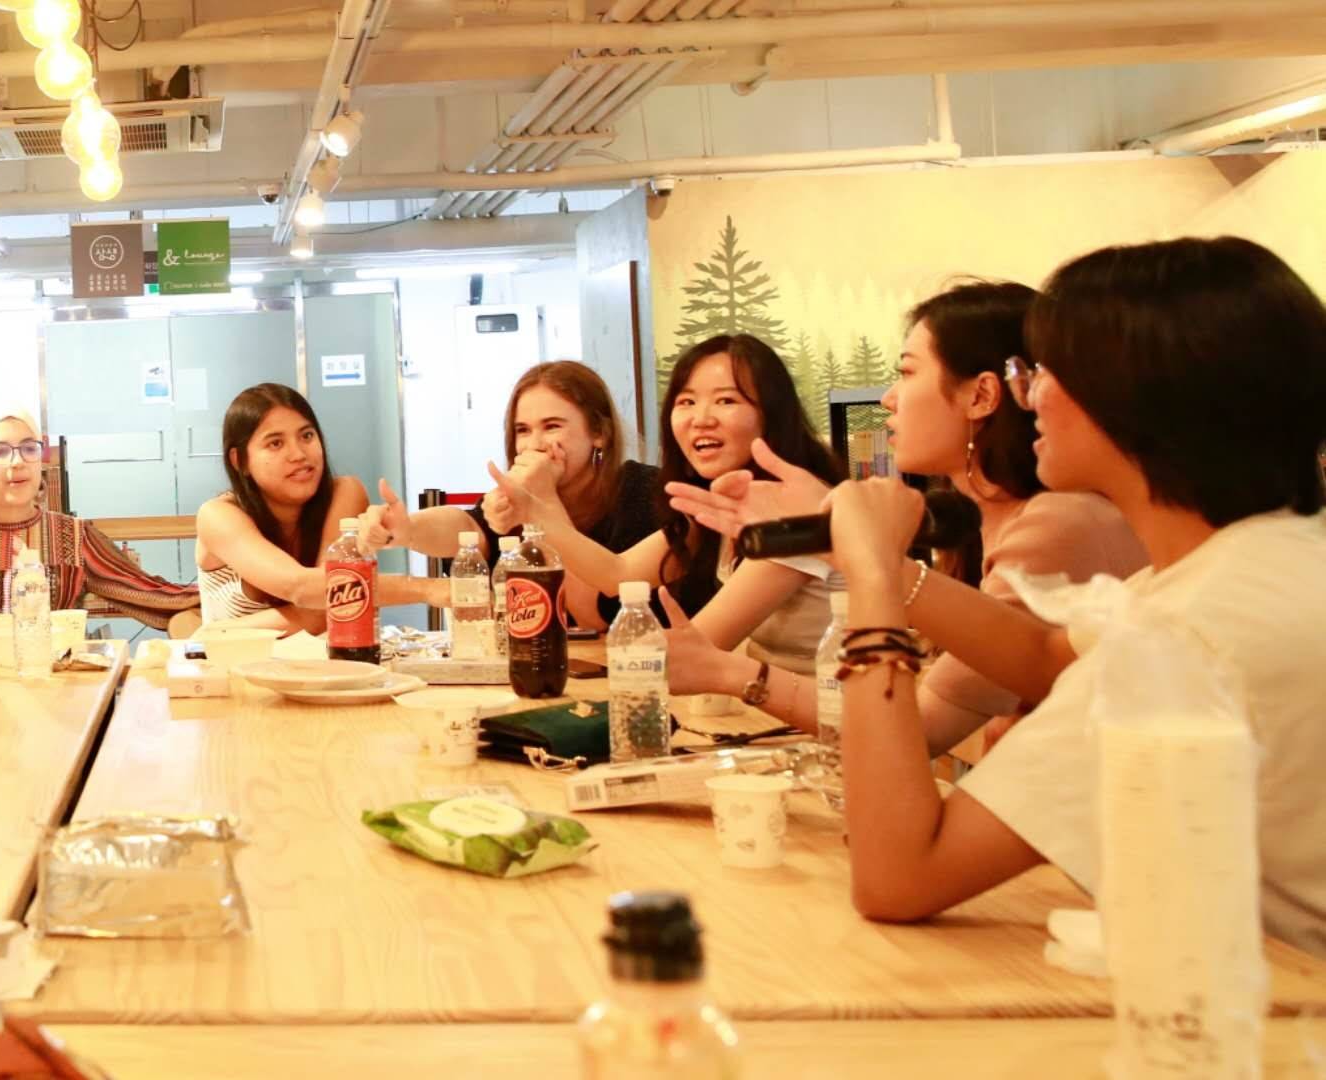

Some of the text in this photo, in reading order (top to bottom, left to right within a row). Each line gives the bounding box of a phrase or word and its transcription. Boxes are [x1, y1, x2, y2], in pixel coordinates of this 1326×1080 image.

[327, 582, 364, 606] Cola
[511, 608, 536, 624] Cola
[626, 659, 662, 673] 스파클
